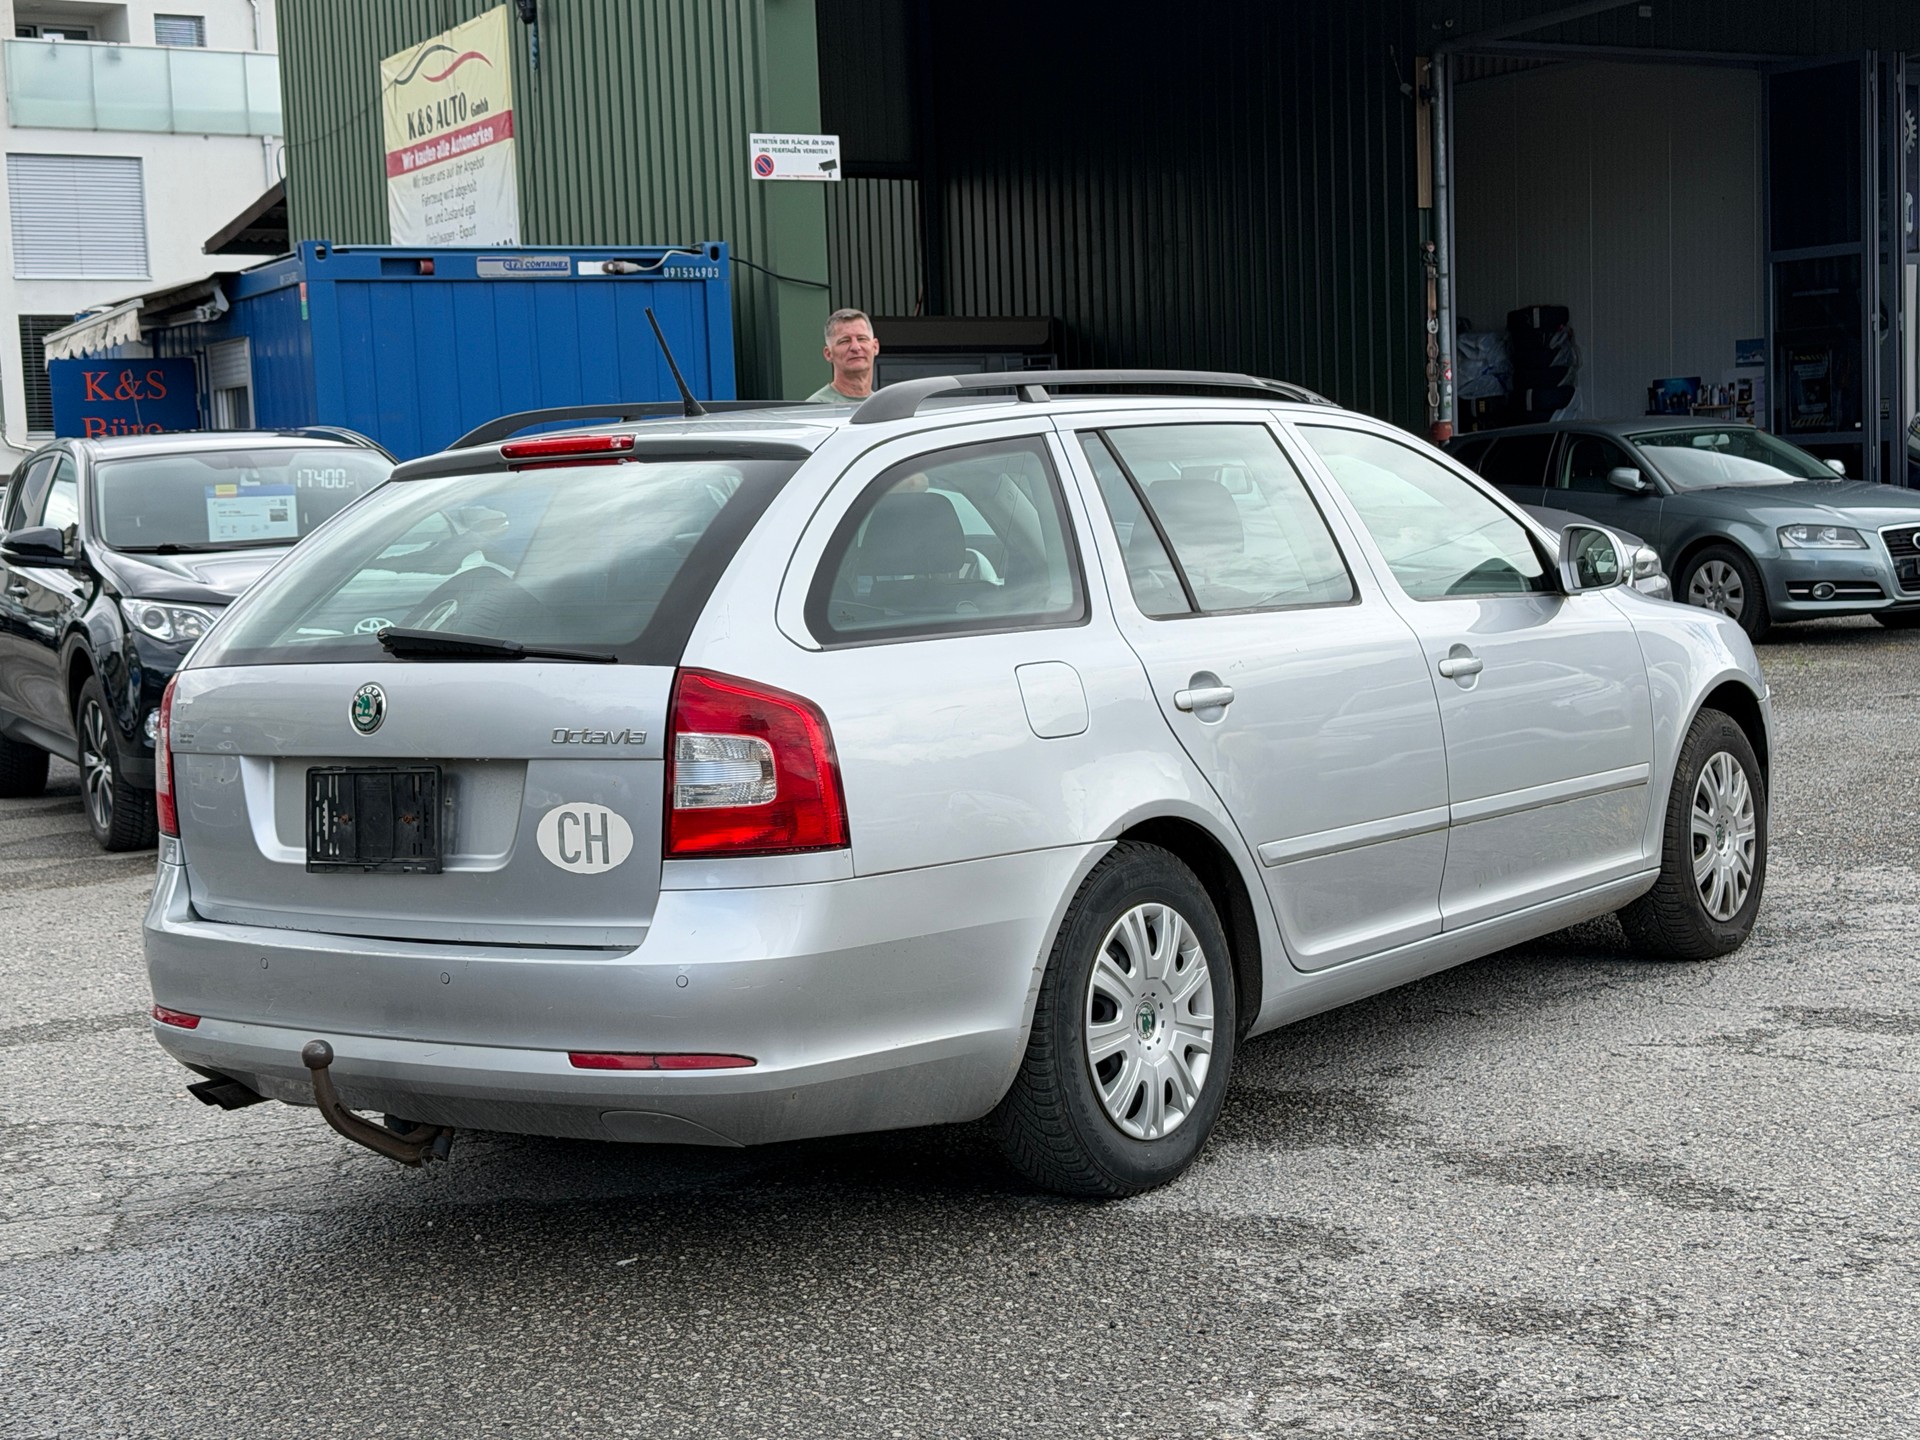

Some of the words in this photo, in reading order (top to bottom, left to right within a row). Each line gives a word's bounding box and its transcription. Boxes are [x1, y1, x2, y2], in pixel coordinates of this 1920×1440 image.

[407, 105, 432, 140] K&S
[436, 92, 467, 130] AUTO
[401, 151, 415, 171] Wir
[414, 145, 436, 167] kaufen
[437, 139, 450, 159] alle
[450, 126, 494, 155] Automarken
[771, 146, 801, 154] FEIERTAGEN
[464, 156, 485, 175] Angebot
[421, 192, 443, 207] Fahrzeug
[444, 203, 464, 221] Zustand
[459, 223, 477, 240] Export
[525, 261, 568, 269] CONTAINEX
[663, 267, 719, 278] 091534903
[82, 370, 167, 401] K&S
[552, 728, 647, 745] Octavia
[557, 811, 610, 865] CH
